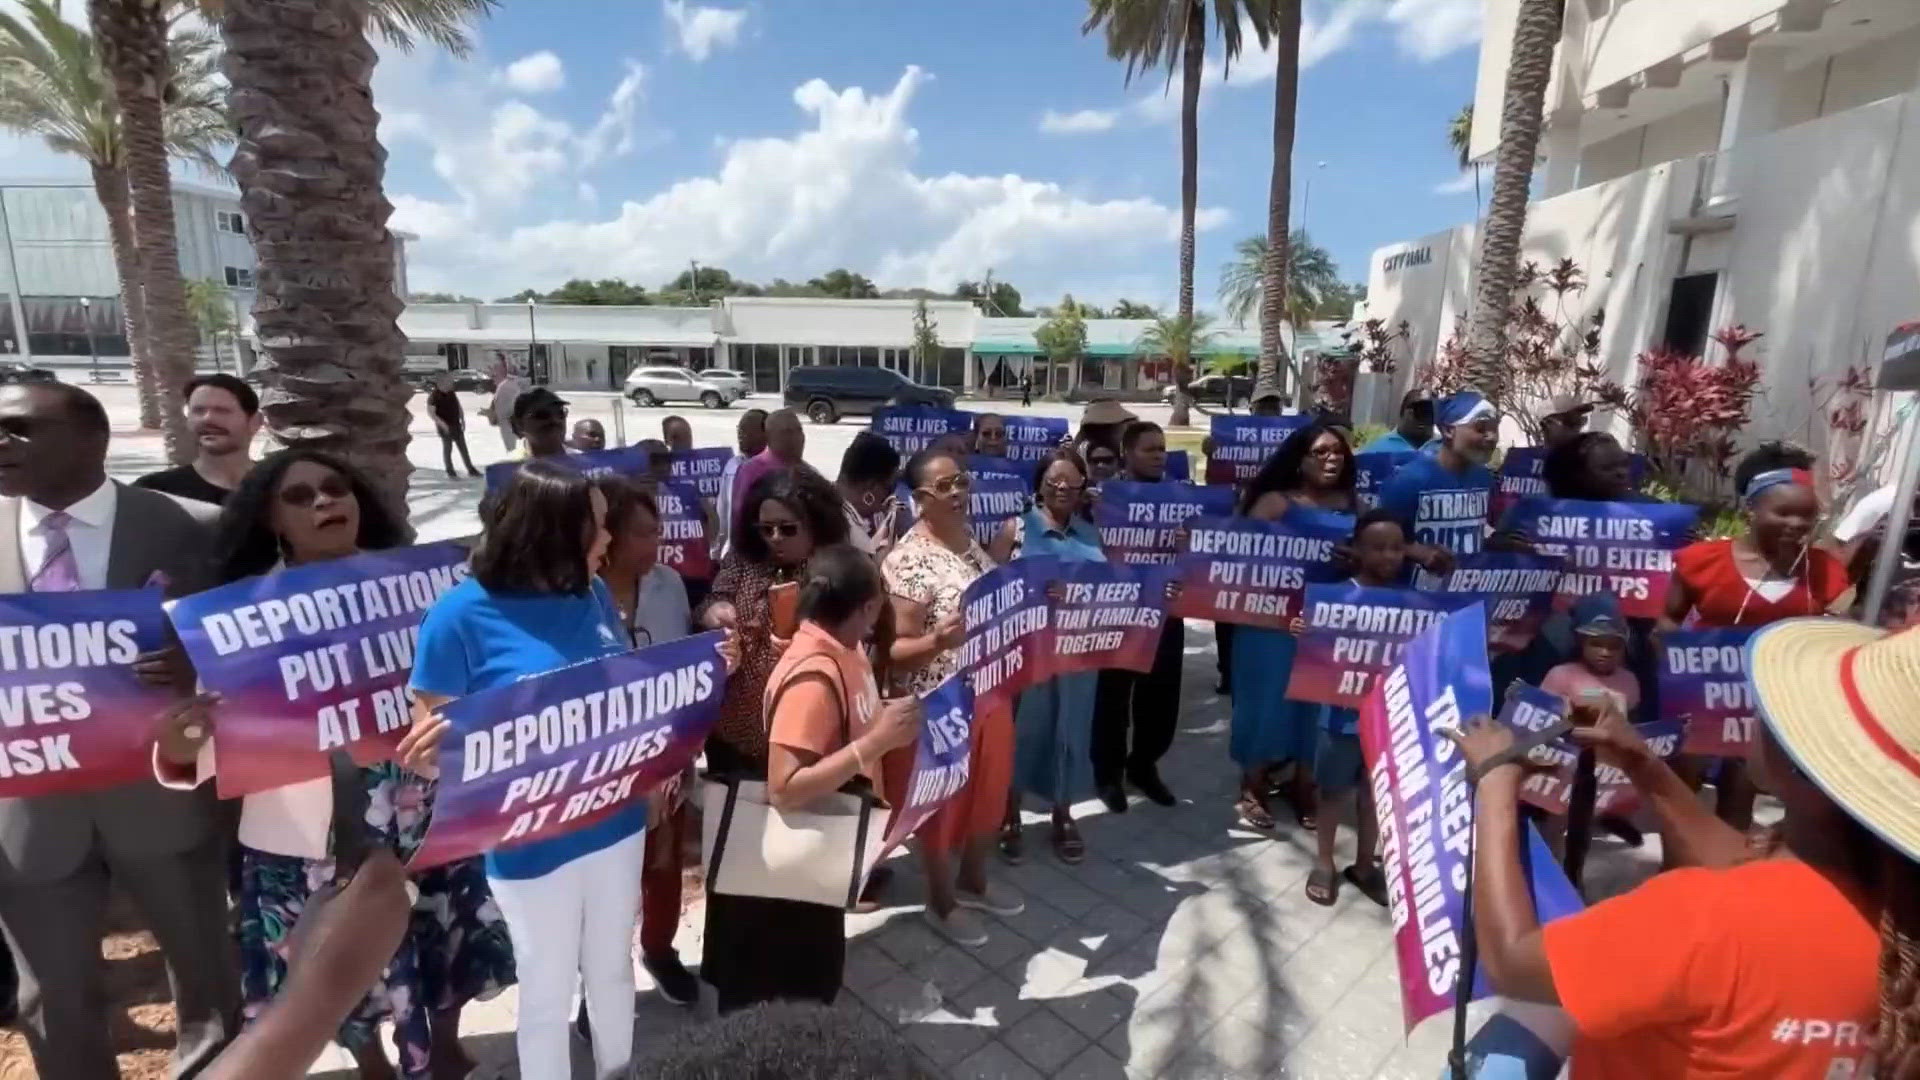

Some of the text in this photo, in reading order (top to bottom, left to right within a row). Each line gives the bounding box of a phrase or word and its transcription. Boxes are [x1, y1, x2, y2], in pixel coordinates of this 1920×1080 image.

[1383, 246, 1432, 272] CITY HALL
[883, 417, 912, 432] SAVE
[916, 418, 948, 434] LIVES
[1018, 426, 1049, 442] LIVES
[1236, 427, 1257, 442] TPS
[691, 459, 721, 474] LIVES
[1128, 503, 1204, 523] TPS KEEPS
[1420, 491, 1489, 520] STRAIGHT
[1538, 515, 1590, 538] SAVE
[1595, 518, 1654, 541] LIVES
[1190, 529, 1335, 563] DEPORTATIONS
[1574, 545, 1600, 567] TO
[1606, 547, 1672, 572] EXTEN
[1208, 561, 1306, 589] PUT LIVES
[1447, 569, 1560, 592] DEPORTATIONS
[1610, 576, 1649, 600] TPS
[965, 595, 994, 633] SAVE
[996, 578, 1024, 613] LIVES
[1065, 582, 1142, 604] TPS KEEPS
[1215, 590, 1290, 616] AT RISK
[985, 627, 1001, 655] TO
[1002, 605, 1048, 646] EXTEND
[1092, 607, 1161, 629] FAMILIES
[1055, 631, 1125, 655] TOGETHER
[1333, 637, 1379, 664] PUT
[279, 643, 352, 701] PUT
[1004, 645, 1023, 679] TPS
[1337, 671, 1369, 695] AT
[1704, 681, 1753, 710] PUT
[317, 698, 361, 751] AT
[462, 661, 714, 783] DEPORTATIONS
[1384, 665, 1430, 801] HAITIAN
[1722, 717, 1755, 743] AT
[500, 725, 673, 813] PUT LIVES
[1524, 773, 1560, 796] AT
[501, 805, 556, 842] AT
[558, 770, 642, 824] RISK
[1372, 751, 1409, 936] TOGETHER
[1406, 798, 1461, 996] FAMILIES
